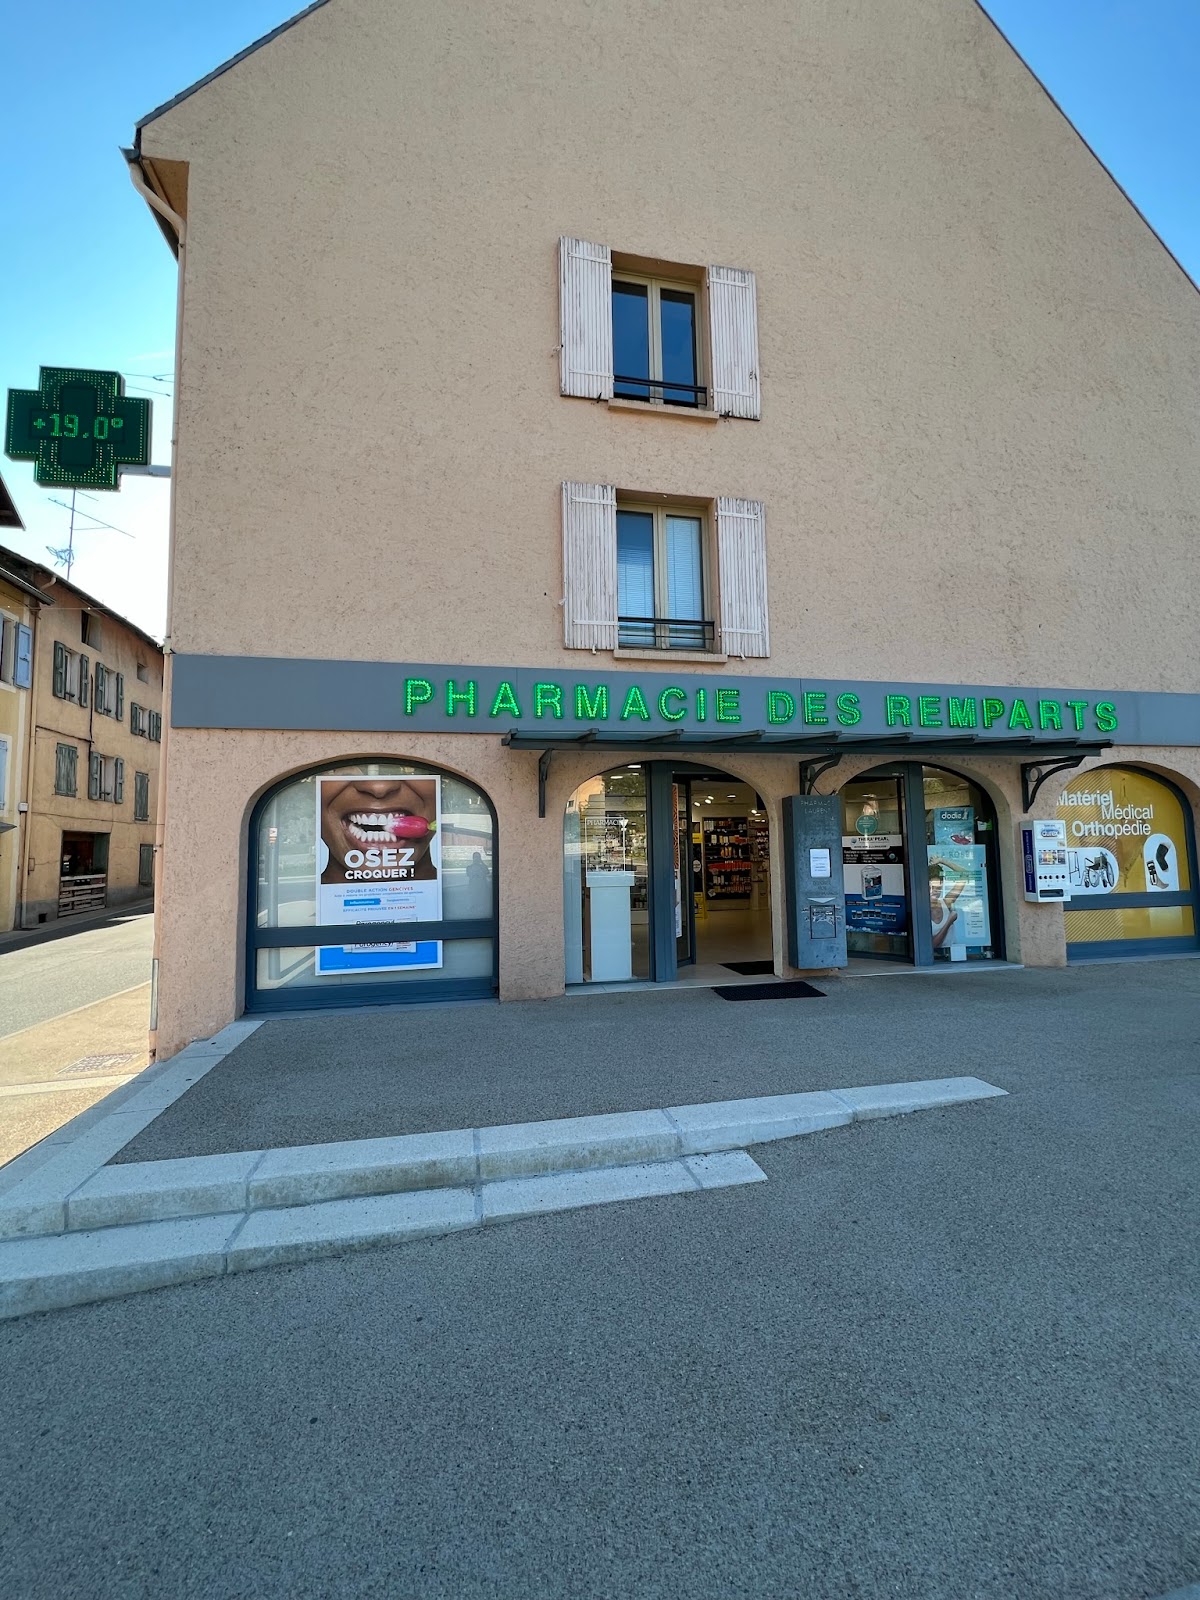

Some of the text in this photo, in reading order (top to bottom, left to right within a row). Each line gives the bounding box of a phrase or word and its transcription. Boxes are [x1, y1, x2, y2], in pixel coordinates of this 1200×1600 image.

[405, 678, 1118, 732] PHARMACIE DES REMPARTS
[1056, 789, 1113, 806] Matériel
[1101, 804, 1154, 820] Médical
[1072, 820, 1152, 840] Orthopédie
[344, 847, 415, 868] OSEZ
[344, 868, 415, 880] CROQUER !
